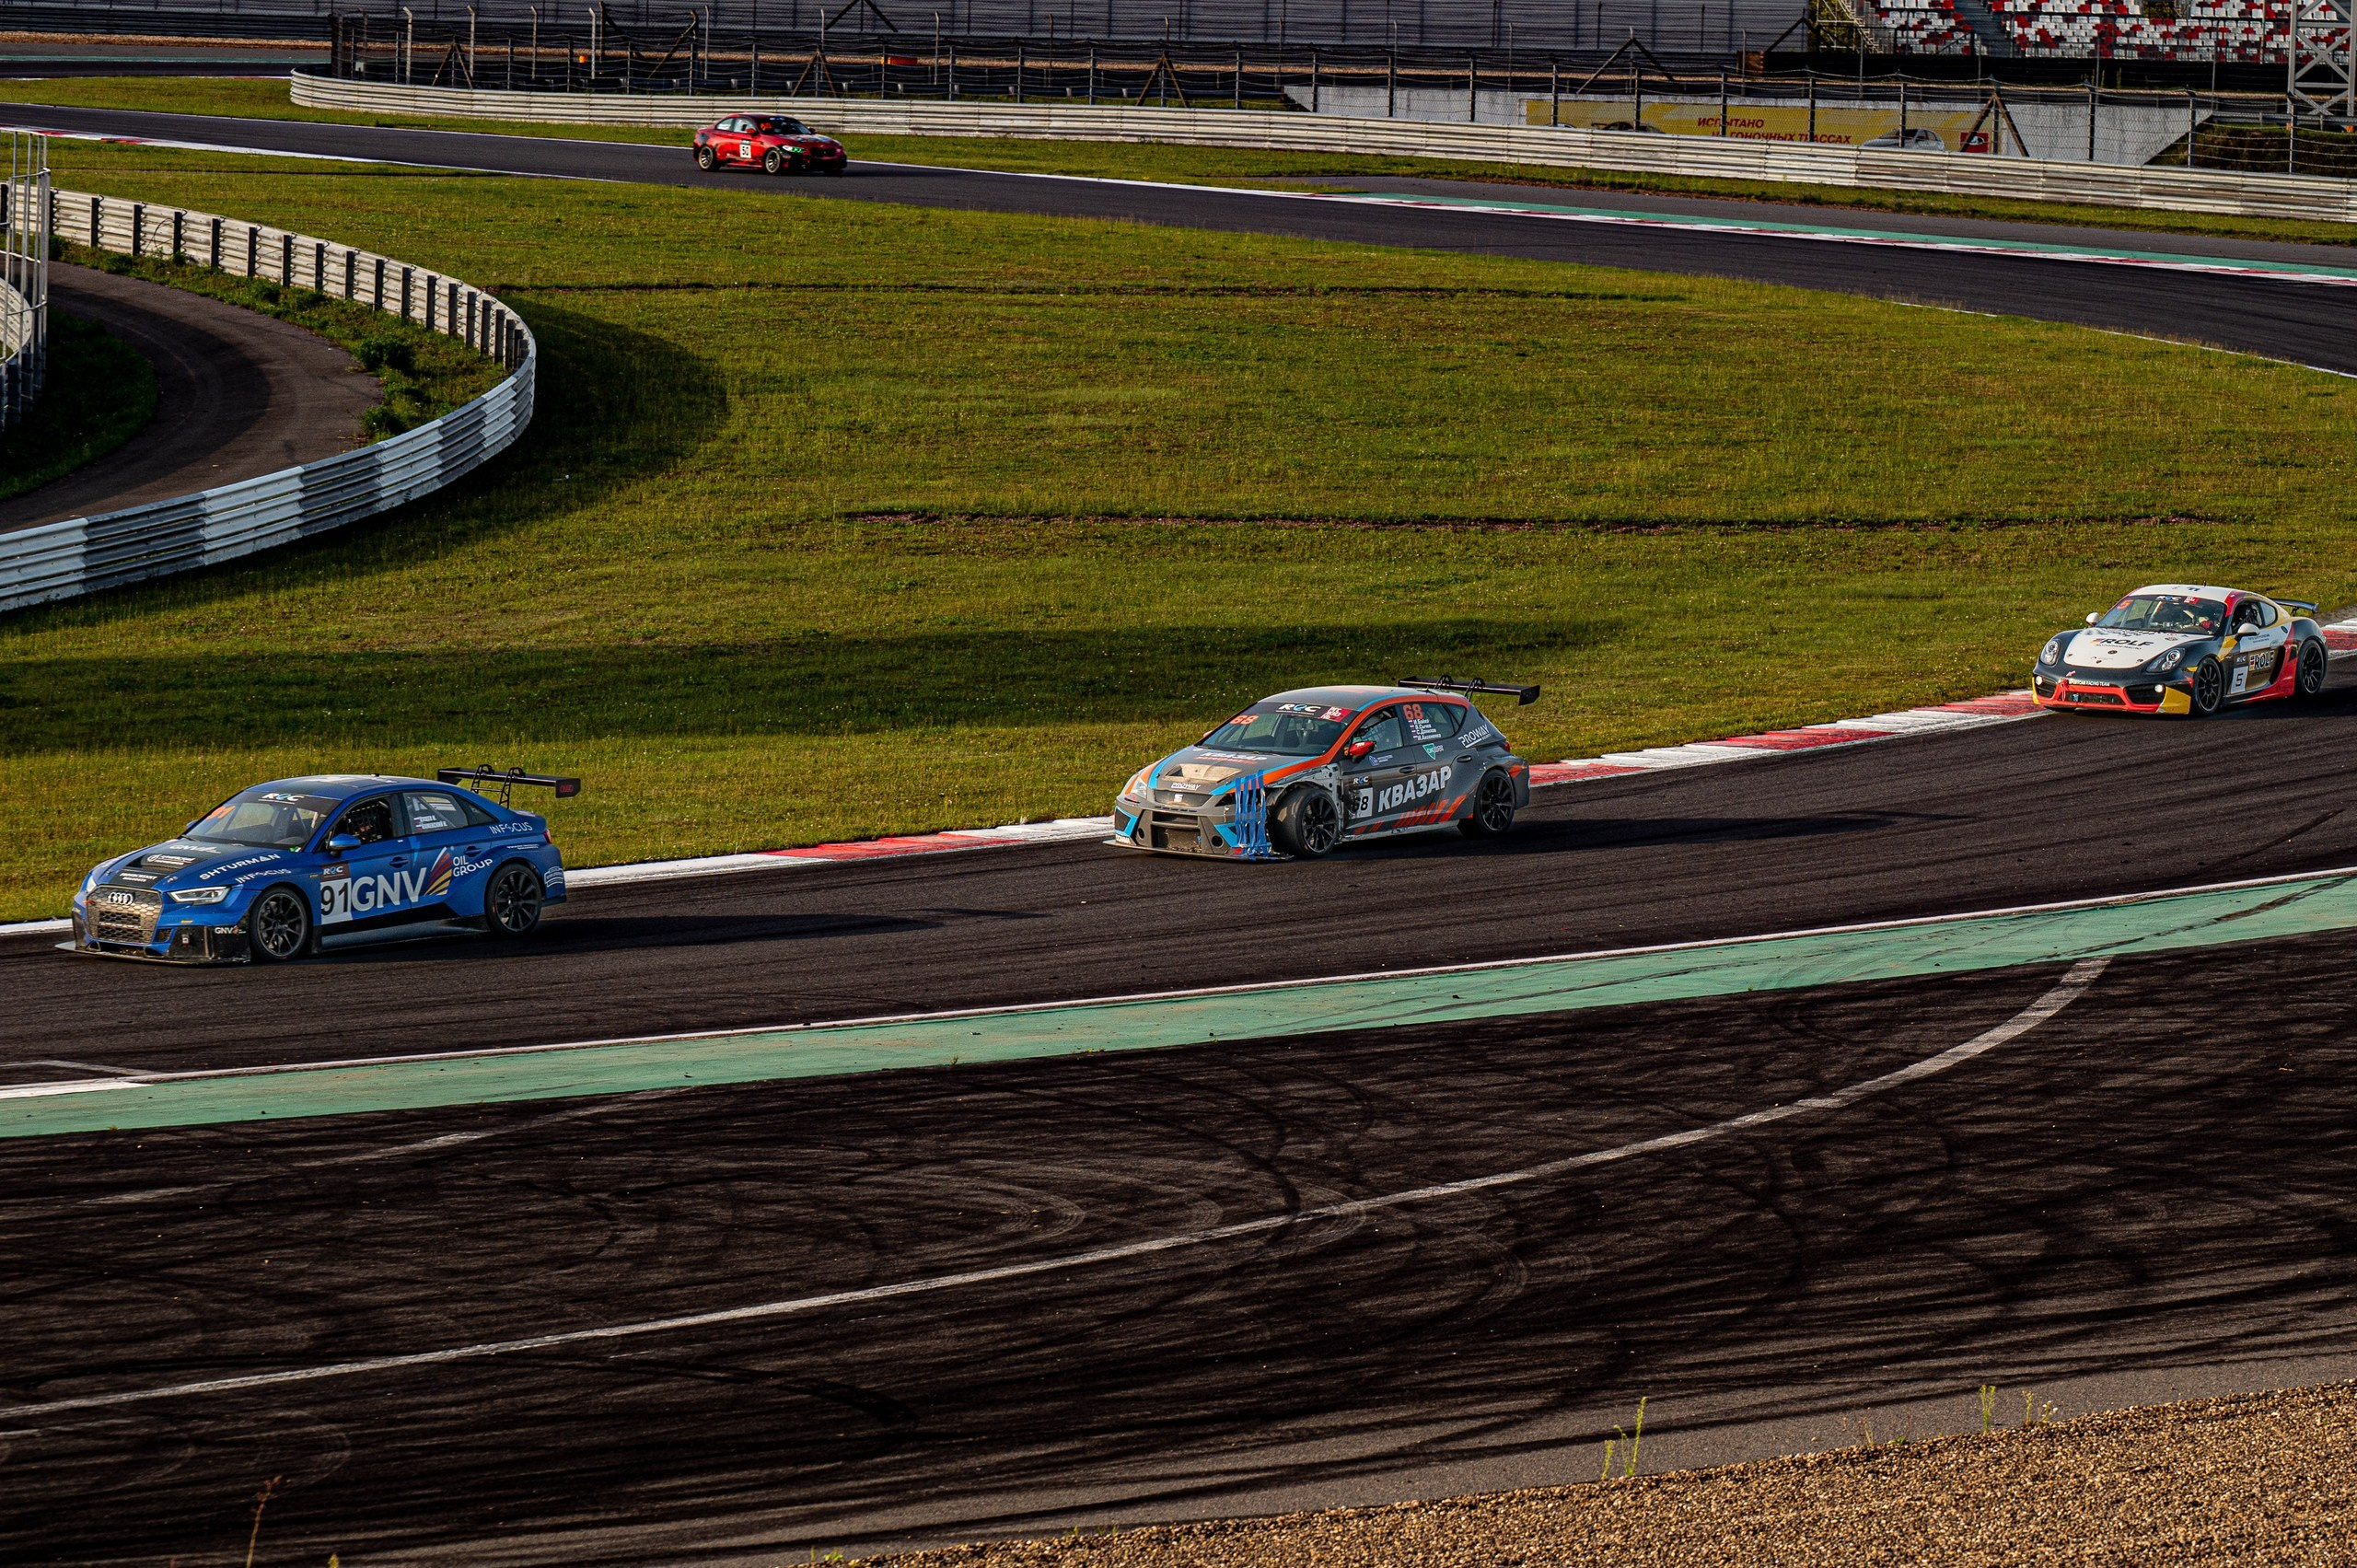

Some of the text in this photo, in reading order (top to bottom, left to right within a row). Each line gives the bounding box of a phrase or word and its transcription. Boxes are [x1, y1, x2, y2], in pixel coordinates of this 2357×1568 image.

[2117, 599, 2133, 610] 5
[2099, 638, 2154, 646] ROLF
[2254, 650, 2275, 669] ROLF
[2235, 672, 2244, 687] 5
[1230, 714, 1259, 725] 68
[1403, 703, 1423, 720] 68
[1458, 725, 1491, 747] PROWAY
[1377, 765, 1452, 813] КВАЗАР
[199, 854, 281, 880] SHTURMAN
[452, 855, 470, 866] OIL
[453, 858, 493, 877] GROUP
[351, 866, 427, 912] GNV
[321, 881, 349, 916] 91
[215, 926, 233, 935] GNV
